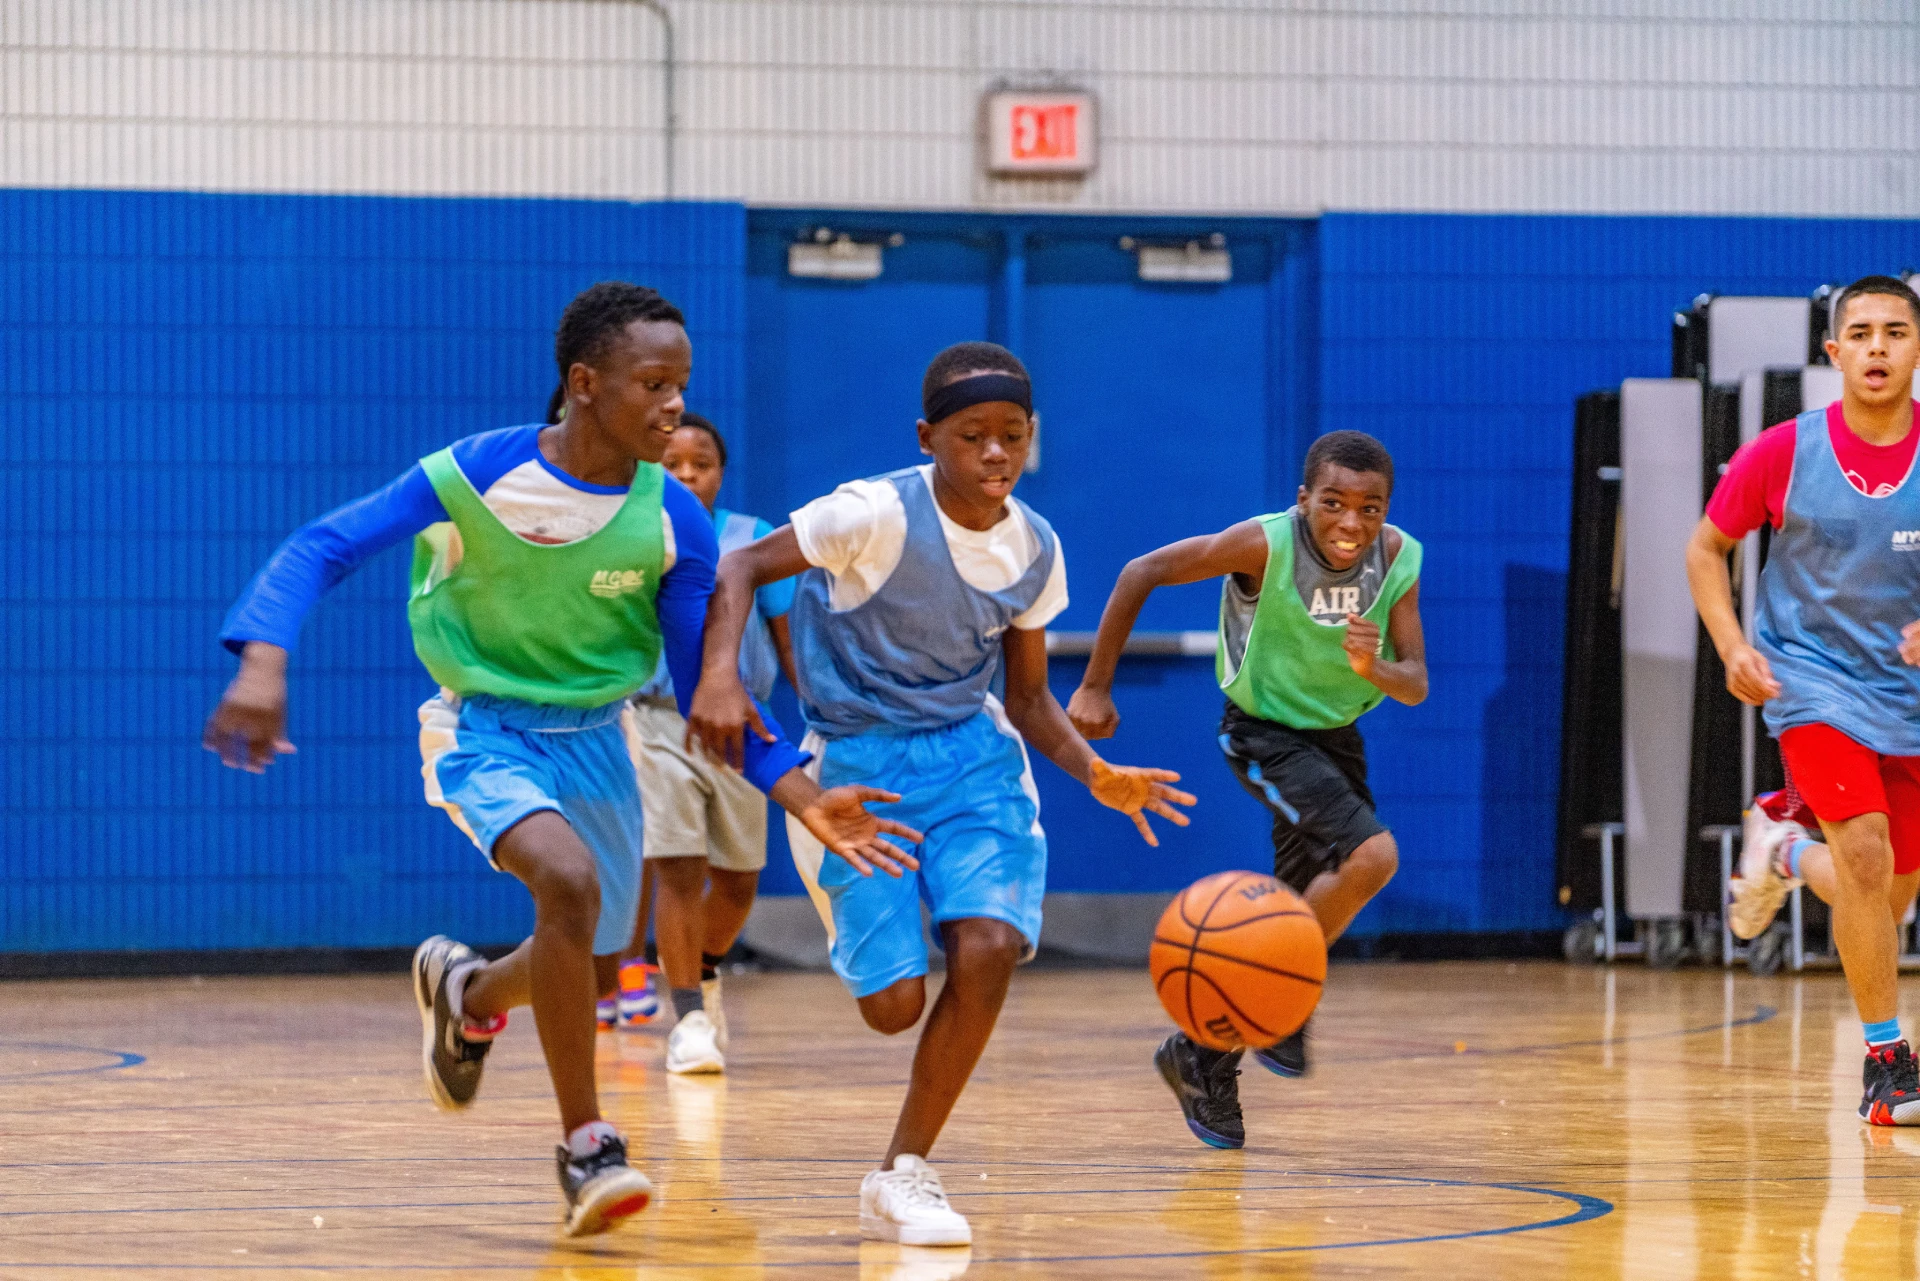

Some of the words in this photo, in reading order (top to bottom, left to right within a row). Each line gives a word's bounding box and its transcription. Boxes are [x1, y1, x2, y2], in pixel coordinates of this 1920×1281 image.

[1011, 104, 1077, 159] EXIT
[1891, 529, 1920, 544] NY
[1308, 586, 1360, 616] AIR
